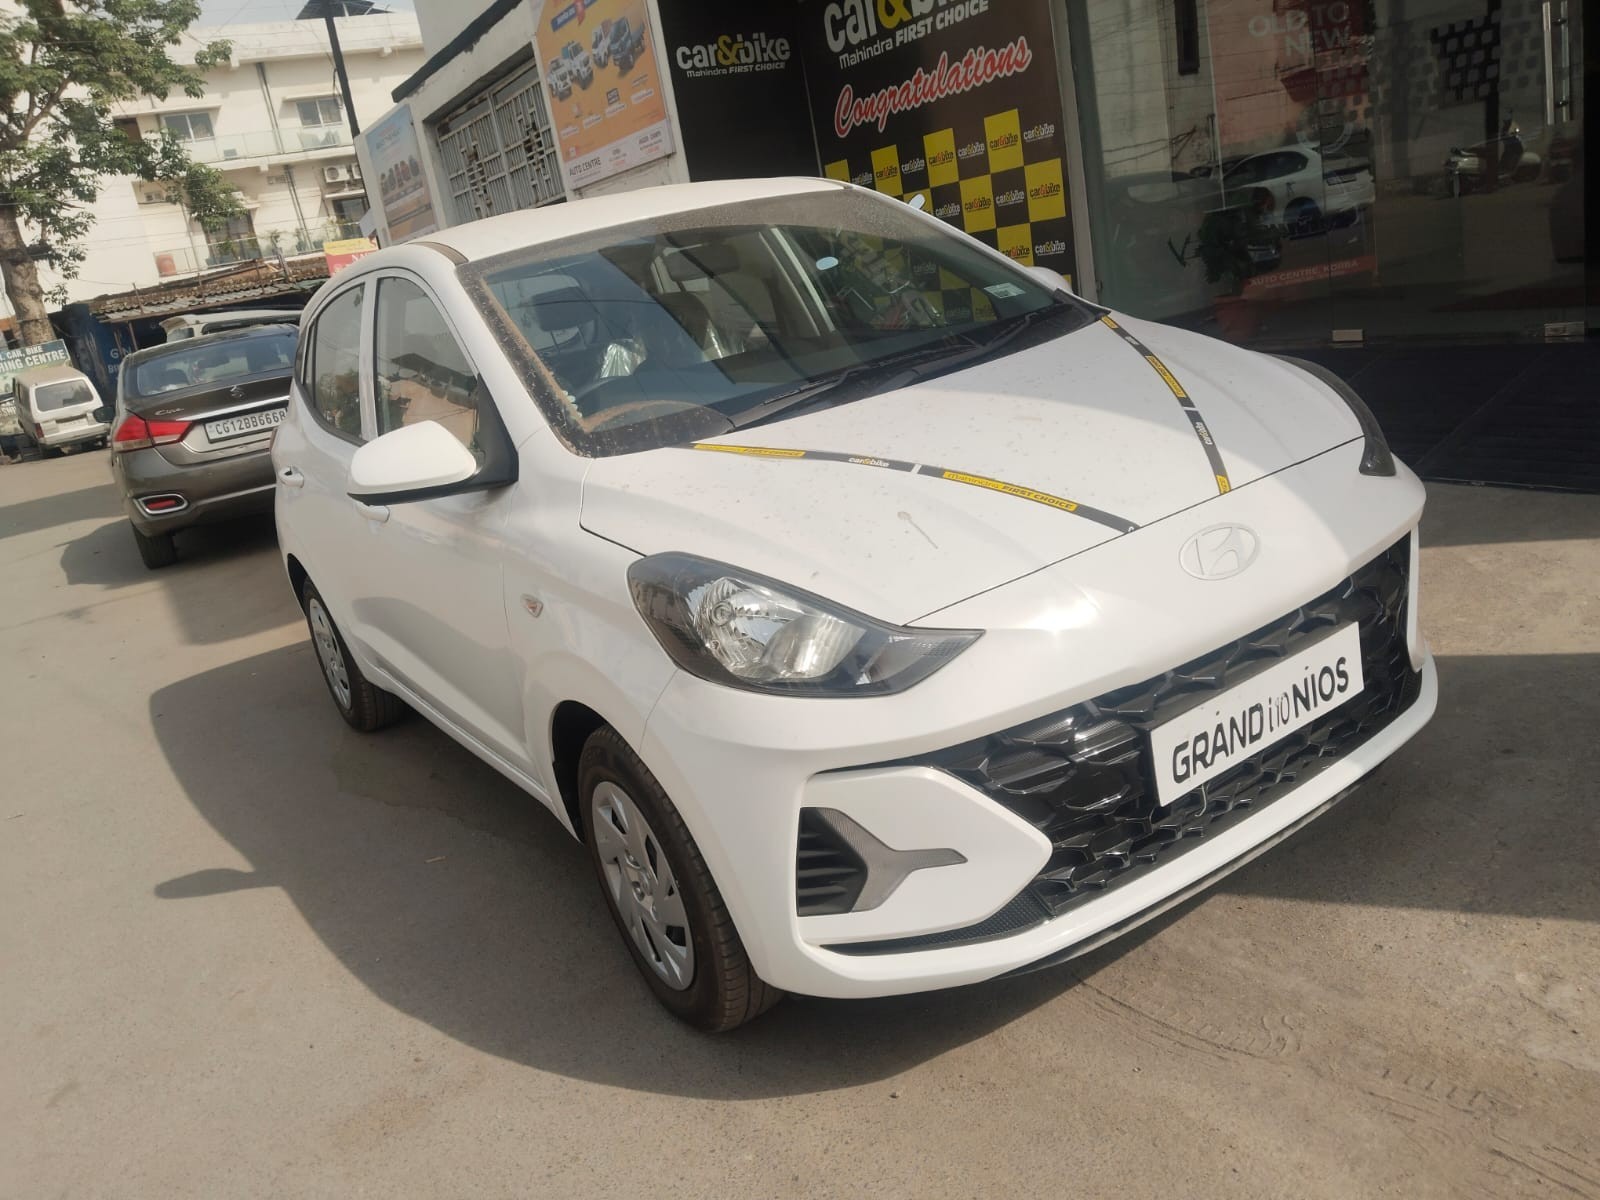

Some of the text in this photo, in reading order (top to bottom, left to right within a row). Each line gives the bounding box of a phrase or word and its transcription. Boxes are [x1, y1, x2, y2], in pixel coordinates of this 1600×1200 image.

[824, 0, 958, 52] car&
[1248, 1, 1350, 38] OLD TO
[839, 0, 989, 70] Mahindra FIRST CHOICE
[1285, 26, 1351, 57] NEW
[676, 32, 791, 69] car&bike
[686, 61, 786, 78] Mahindra FIRST CHOICE
[834, 35, 1032, 138] Congratulations
[1023, 123, 1055, 140] car&bike
[957, 141, 985, 157] car&bike
[990, 132, 1019, 149] car&bike
[901, 158, 925, 172] car&bike
[928, 150, 954, 165] car&bike
[569, 163, 583, 177] AUTO
[995, 190, 1025, 205] car&bike
[1030, 183, 1061, 198] car&bike
[964, 197, 991, 210] car&bike
[1034, 240, 1066, 255] car&bike
[1250, 275, 1277, 287] AUTO
[25, 349, 67, 367] CENTRE
[26, 345, 43, 356] BIKE
[848, 456, 889, 468] car&bike
[1001, 485, 1033, 497] FIRST
[1033, 493, 1073, 509] CHOICE
[1172, 702, 1264, 784] GRAND
[1292, 656, 1349, 719] NIOS
